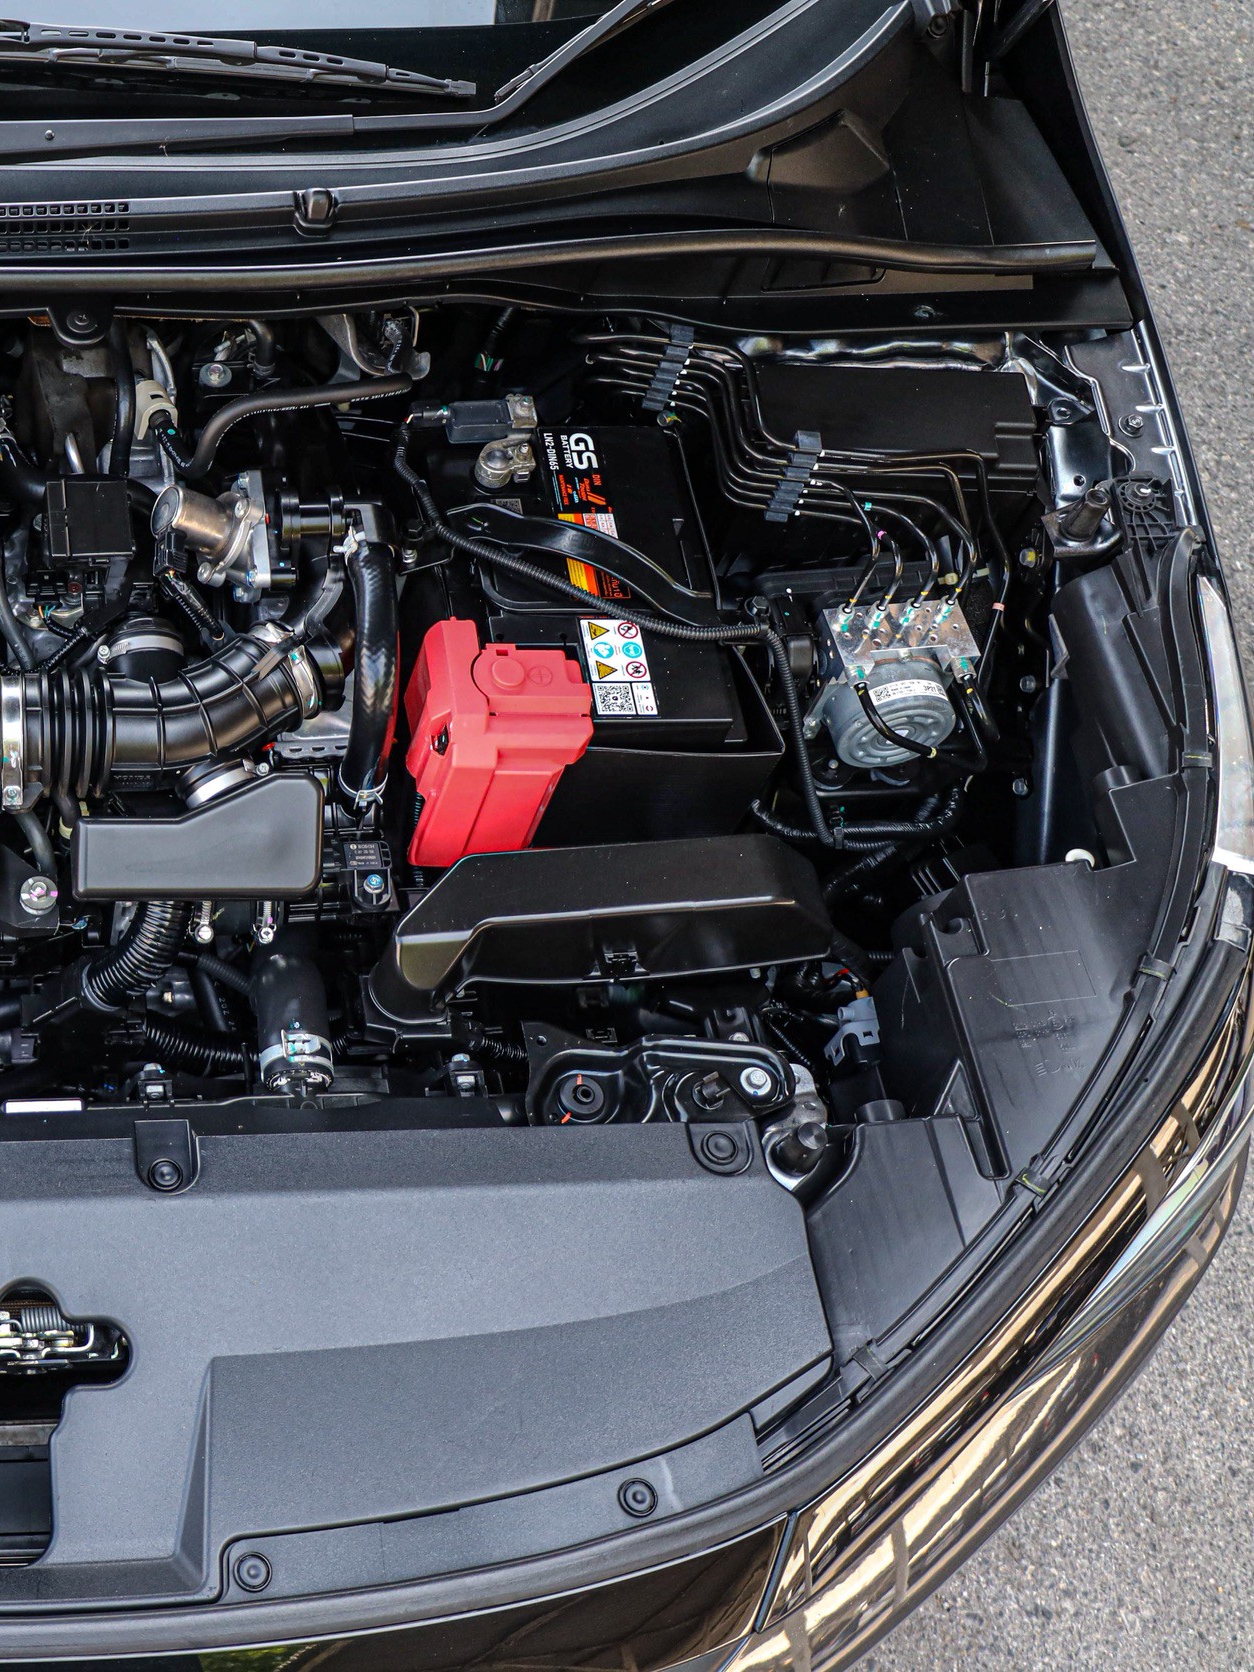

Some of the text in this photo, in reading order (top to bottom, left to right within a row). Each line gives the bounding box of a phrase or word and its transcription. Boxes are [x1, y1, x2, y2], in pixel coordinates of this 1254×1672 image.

[543, 432, 560, 471] LN2-DIN65
[560, 434, 574, 469] BATTERY
[569, 432, 599, 470] GS
[591, 474, 602, 486] DIN
